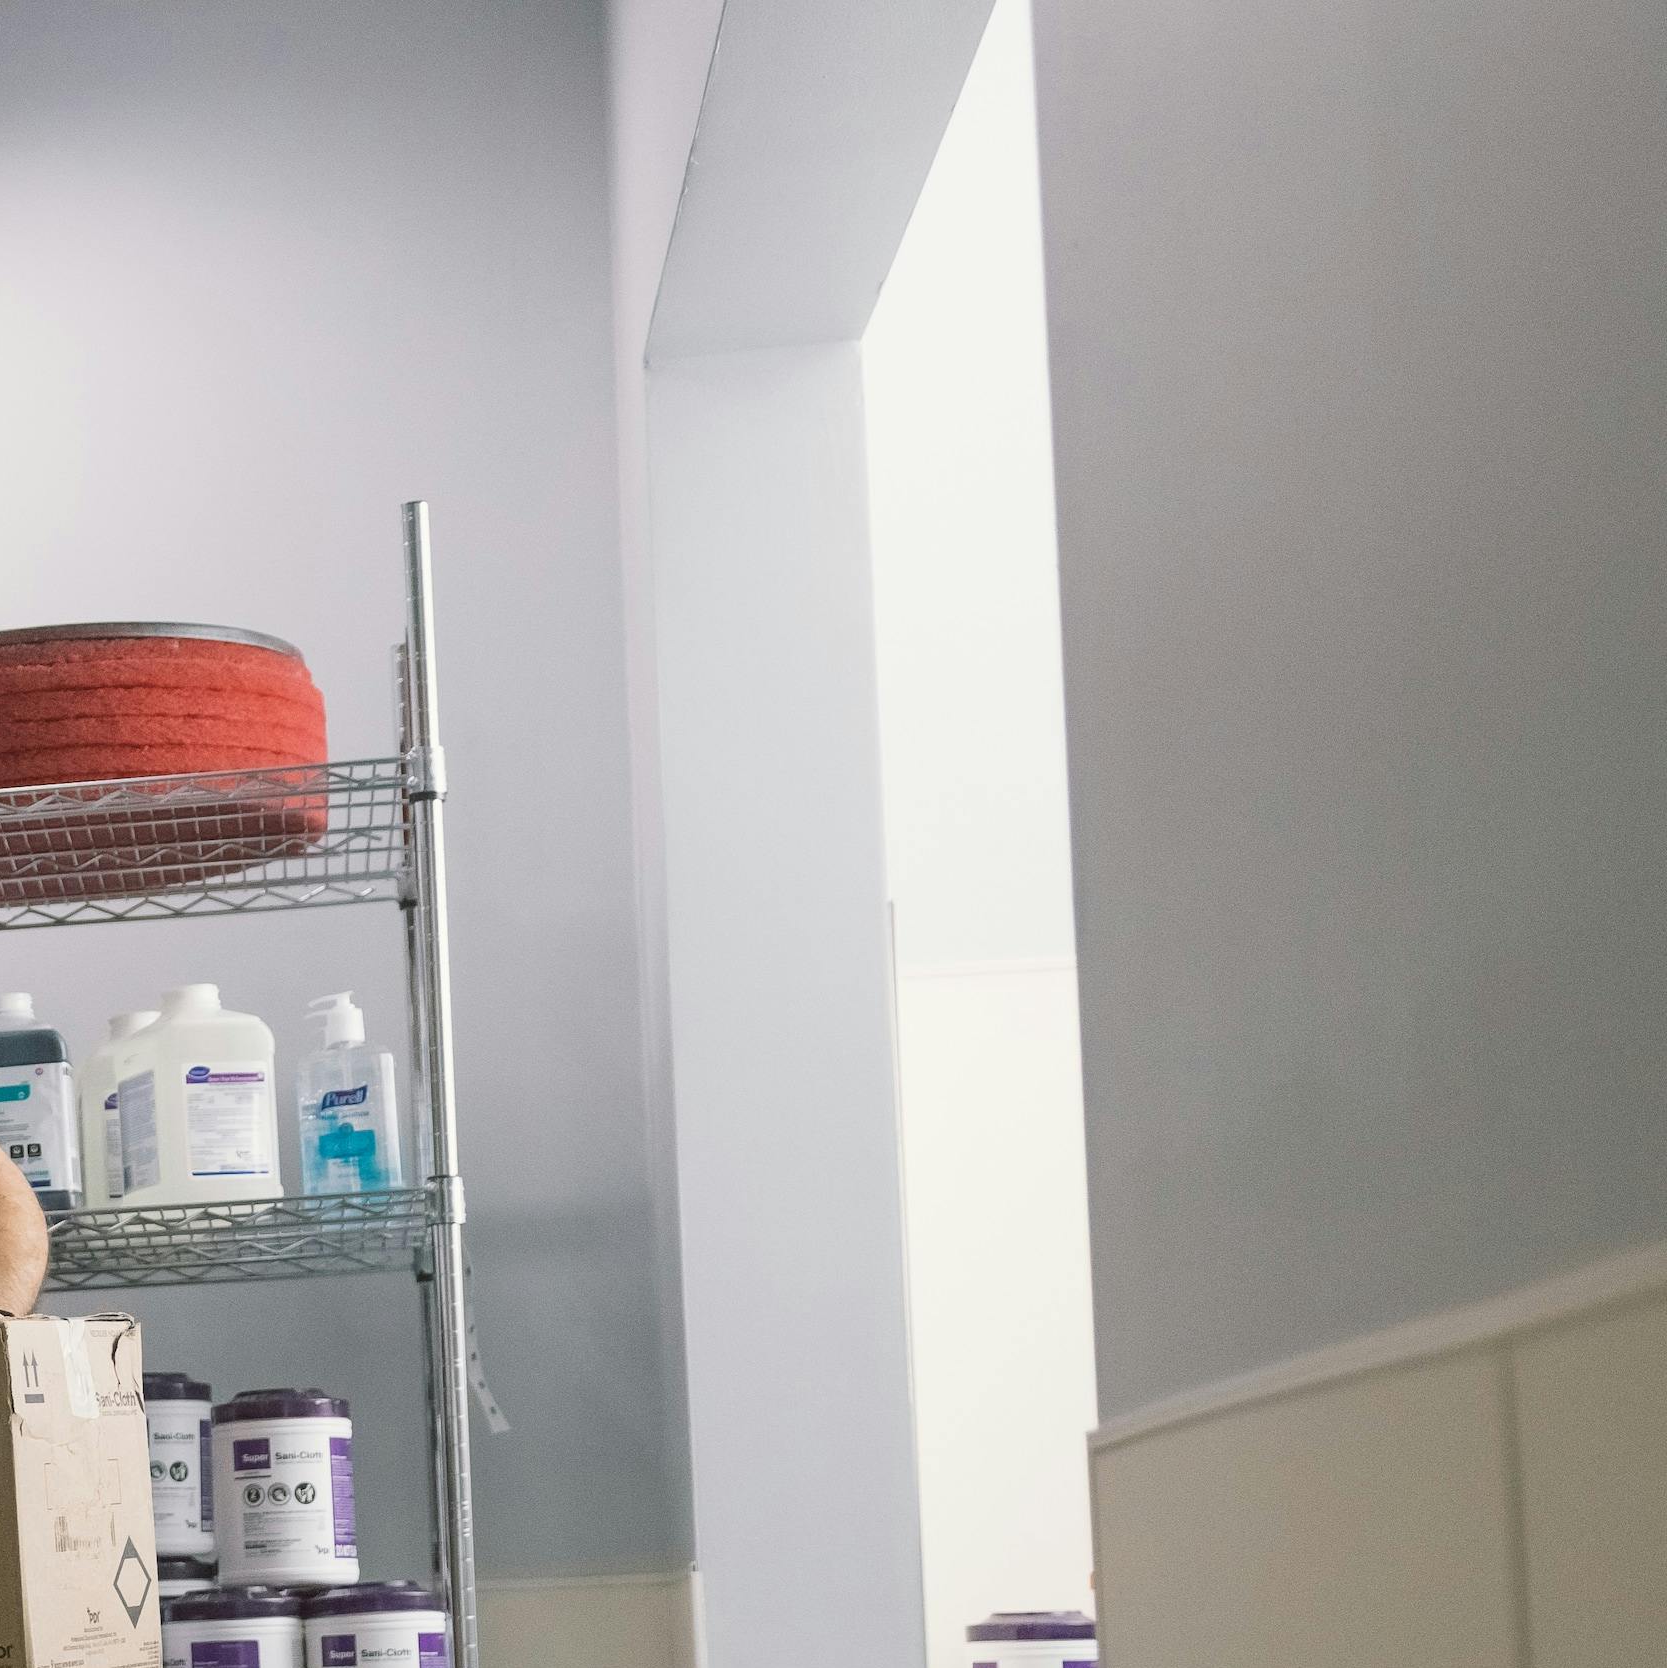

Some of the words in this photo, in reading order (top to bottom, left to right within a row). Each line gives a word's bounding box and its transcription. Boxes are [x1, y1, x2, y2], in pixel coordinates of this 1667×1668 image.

[325, 1089, 365, 1107] Purell
[242, 1452, 270, 1463] Super
[329, 1650, 354, 1659] Super
